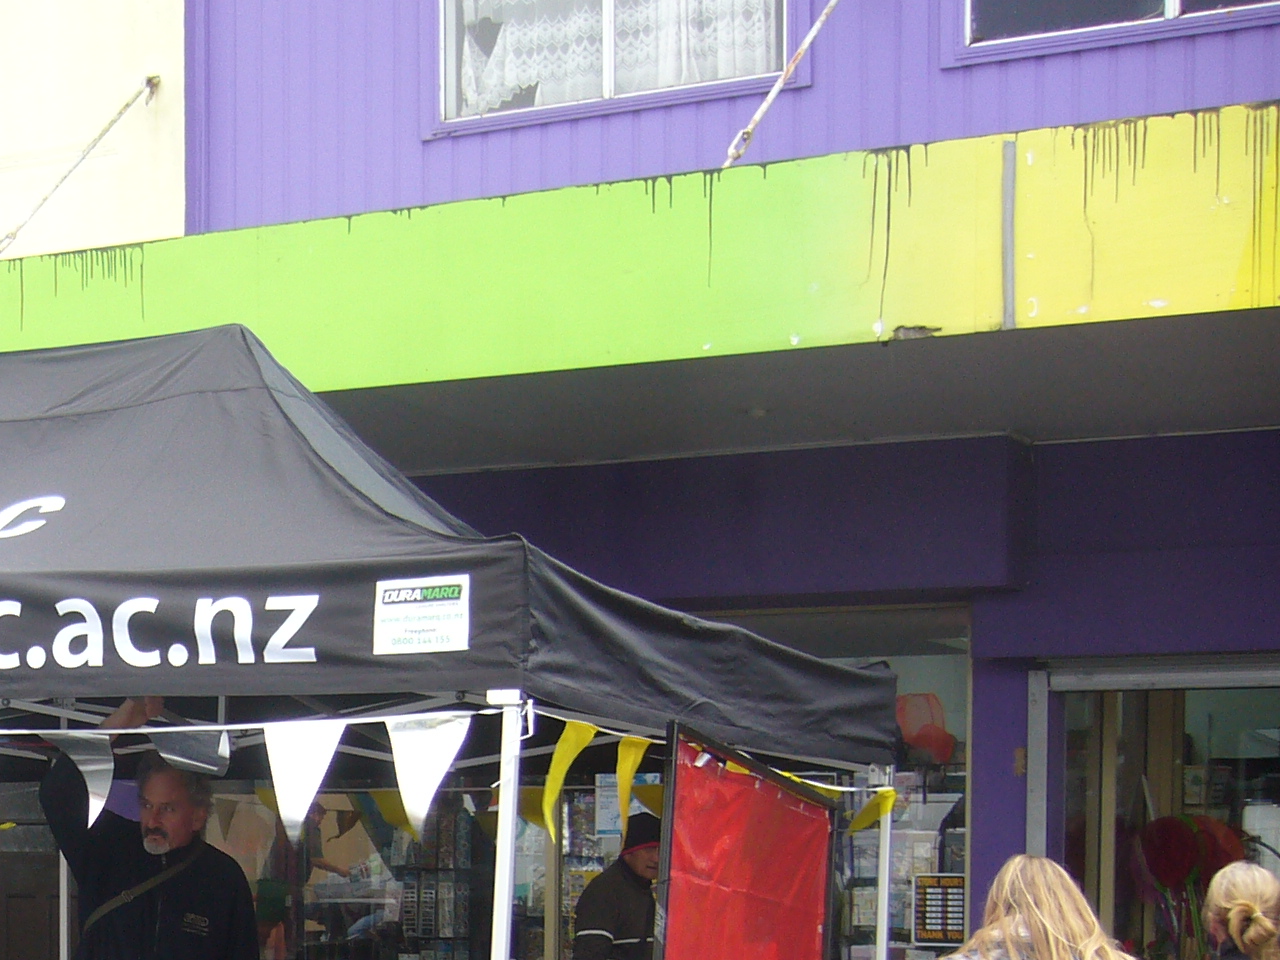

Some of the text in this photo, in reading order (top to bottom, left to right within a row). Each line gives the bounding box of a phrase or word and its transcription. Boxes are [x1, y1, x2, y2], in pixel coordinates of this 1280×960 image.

[383, 586, 460, 603] DURAMARQ
[391, 637, 414, 646] 0800
[917, 930, 963, 940] THANK YOU
